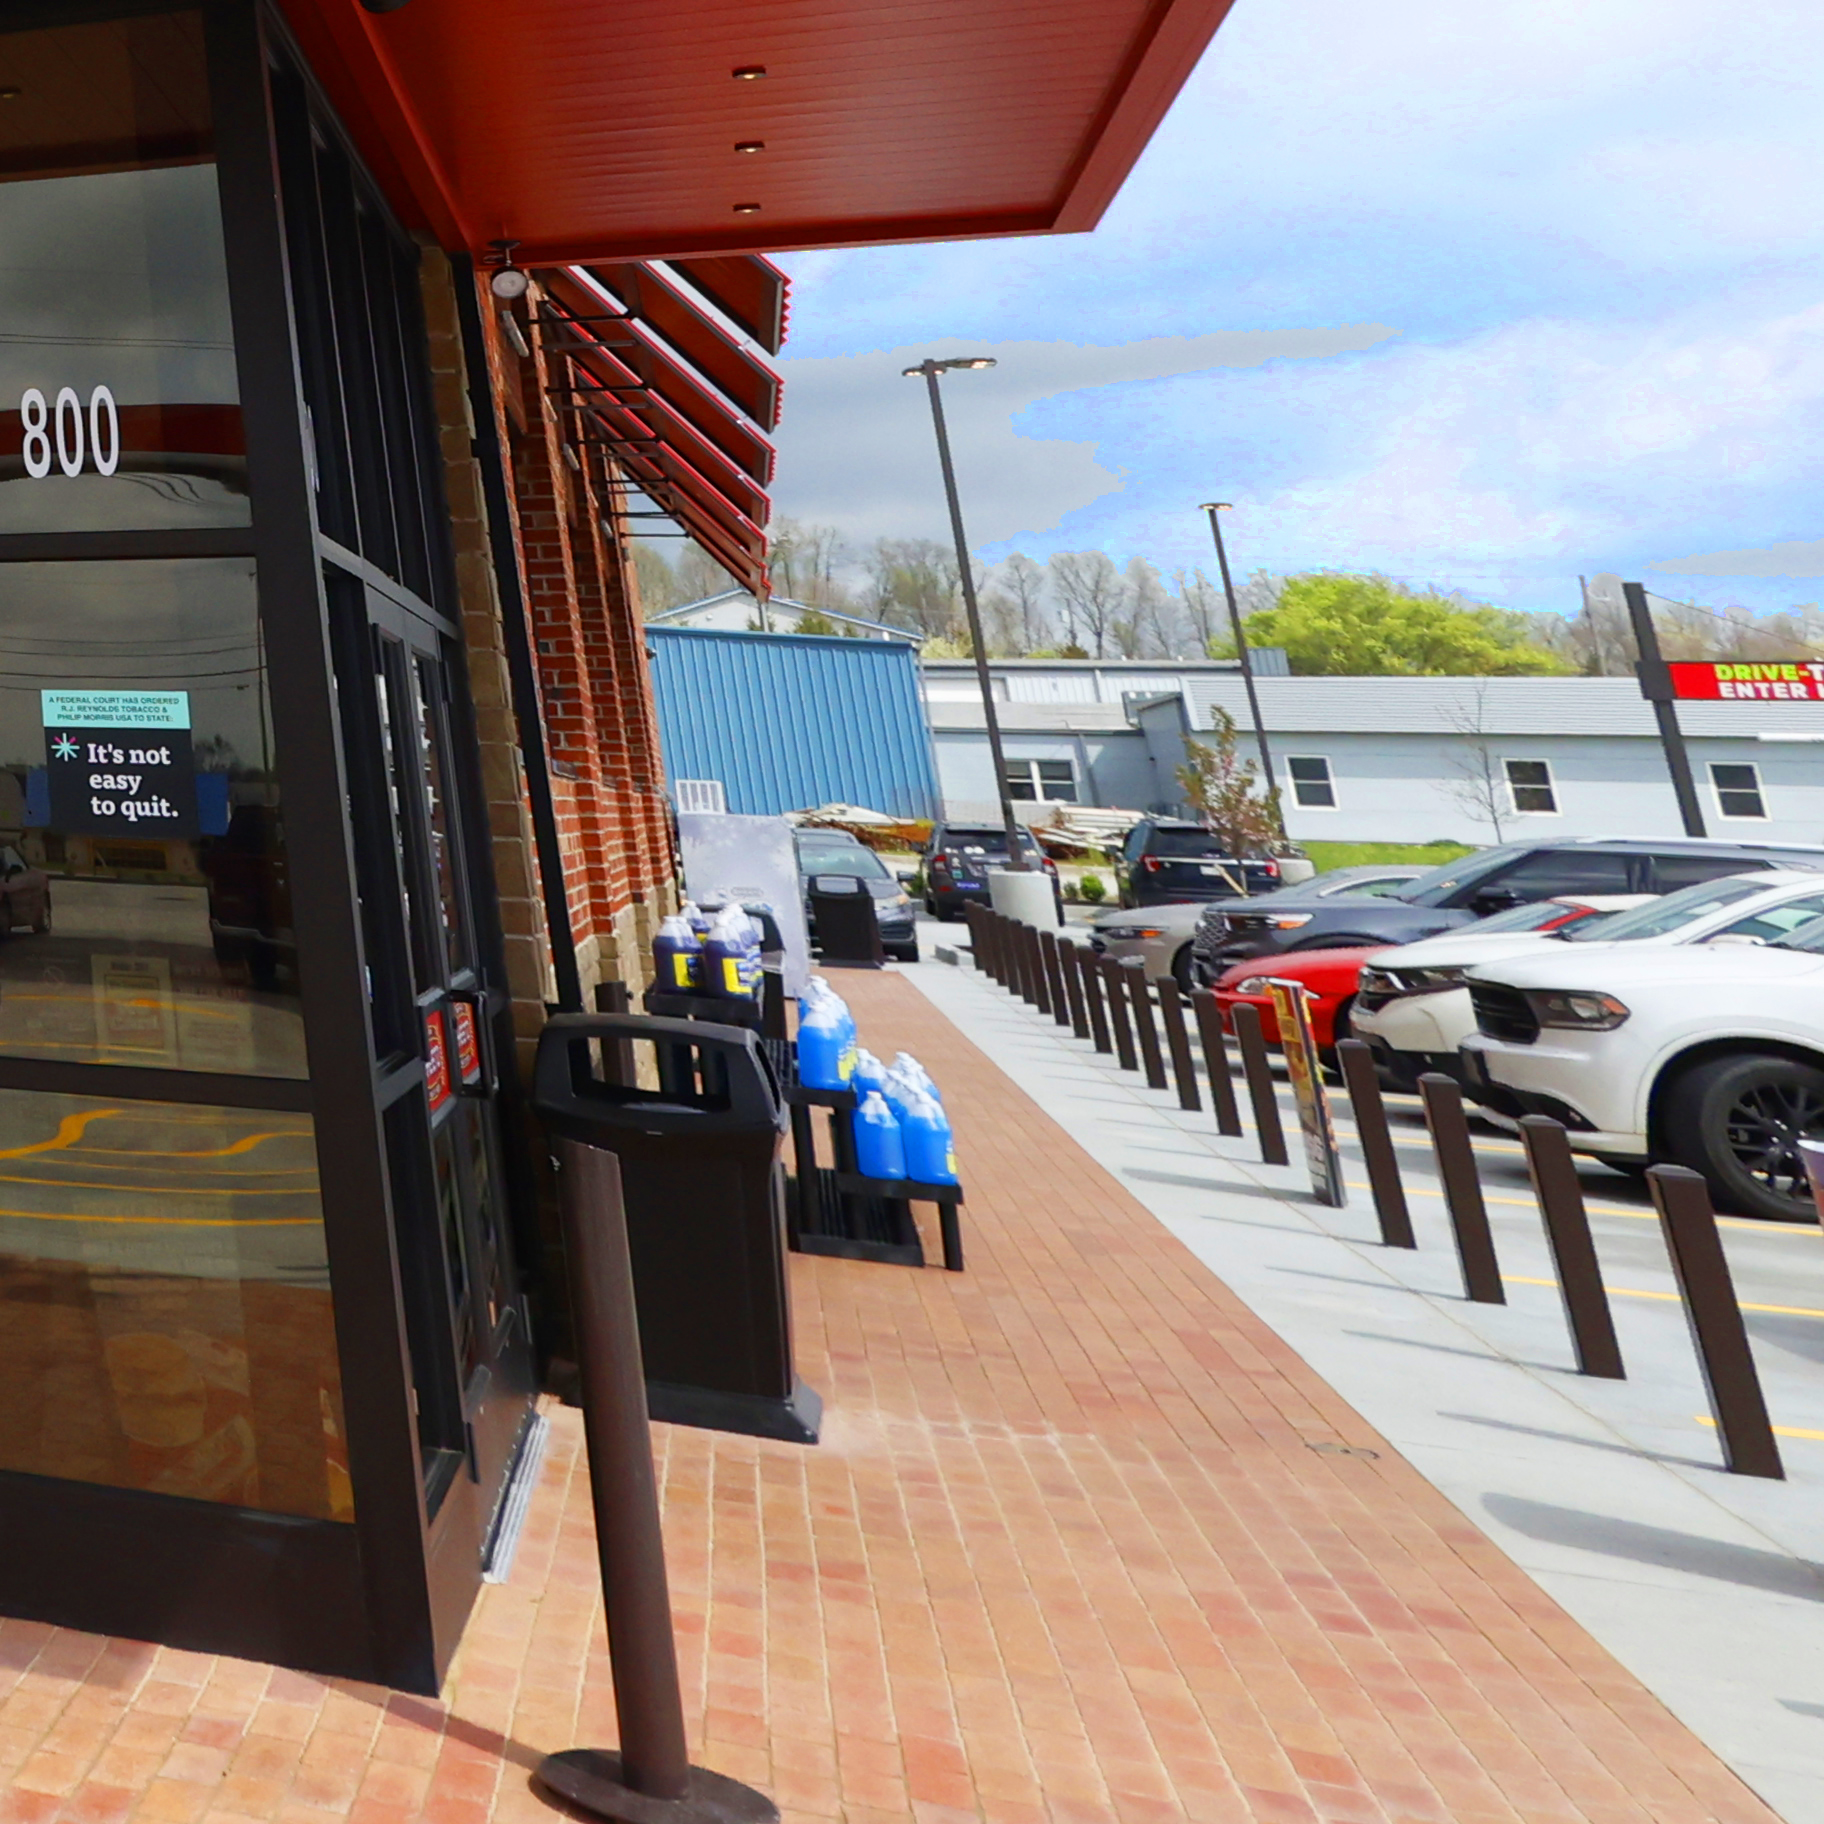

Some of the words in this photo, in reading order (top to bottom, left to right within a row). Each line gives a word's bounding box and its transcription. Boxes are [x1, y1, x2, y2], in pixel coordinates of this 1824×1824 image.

[20, 385, 120, 478] 800
[1718, 682, 1810, 698] ENTER
[56, 696, 91, 704] FEDERAL
[140, 697, 179, 705] ORDERED
[76, 705, 120, 713] REYNOLDS
[83, 714, 114, 722] MORRIS
[116, 714, 132, 722] USA
[86, 742, 125, 764] It's
[128, 746, 172, 765] not
[88, 773, 143, 796] easy
[90, 796, 116, 816] to
[120, 794, 179, 822] quit.
